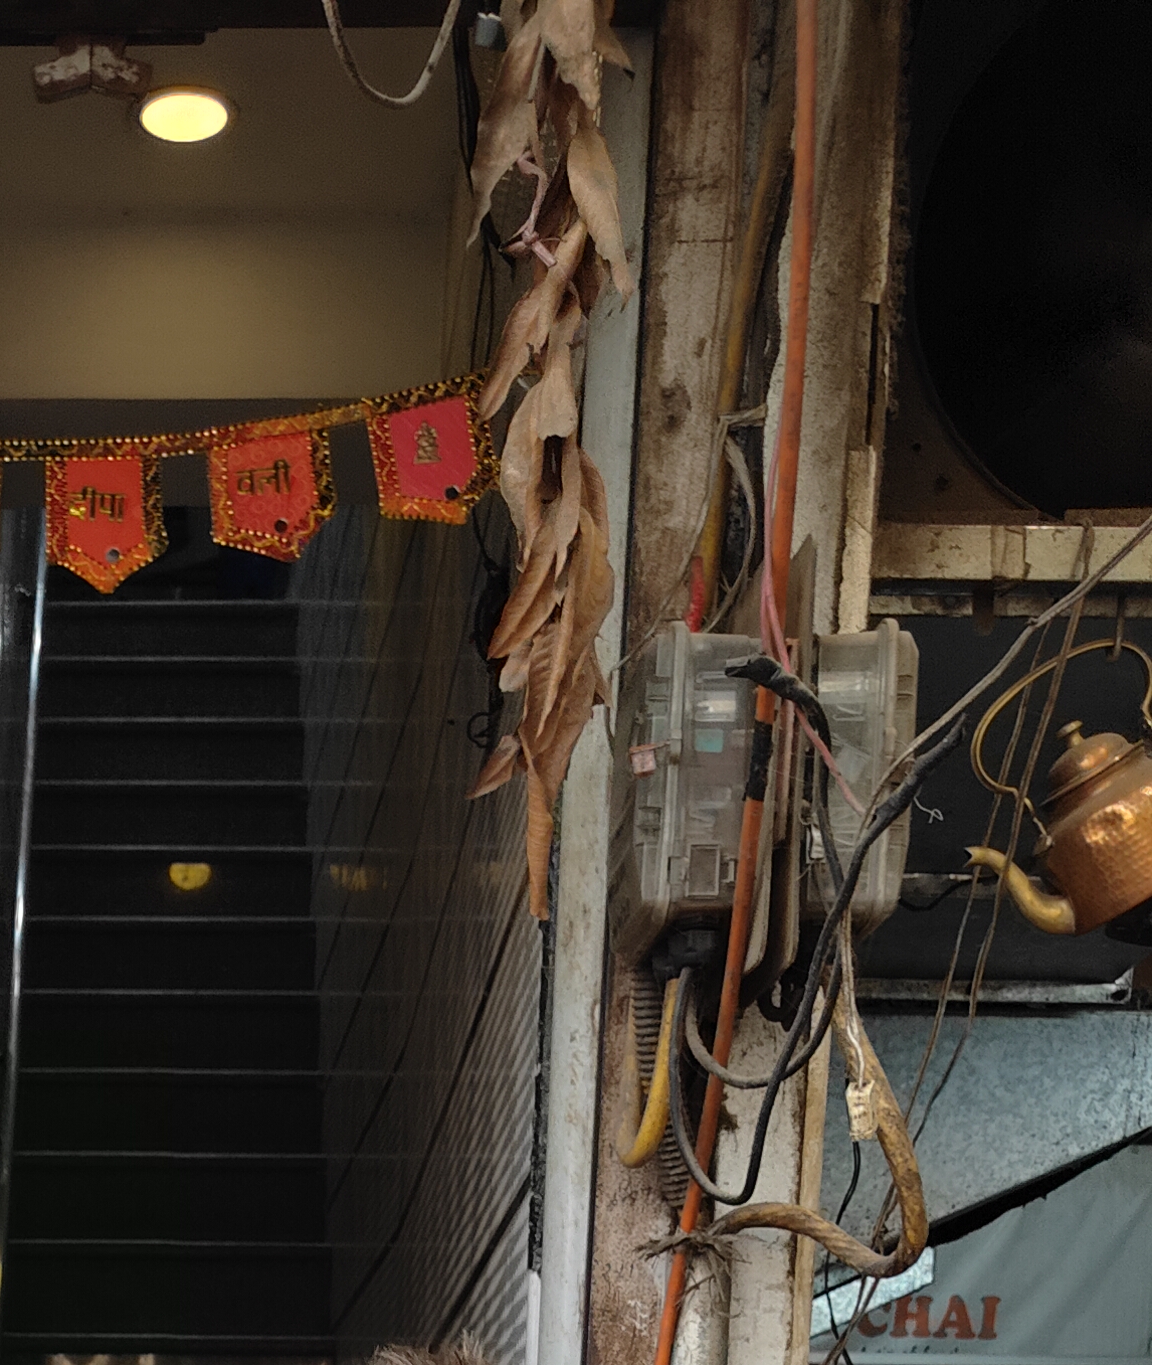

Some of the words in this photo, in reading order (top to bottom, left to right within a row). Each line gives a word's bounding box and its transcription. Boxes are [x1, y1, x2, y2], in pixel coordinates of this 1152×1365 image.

[69, 486, 125, 522] दीपा
[236, 459, 290, 495] वली
[857, 1294, 1002, 1340] CHAI
